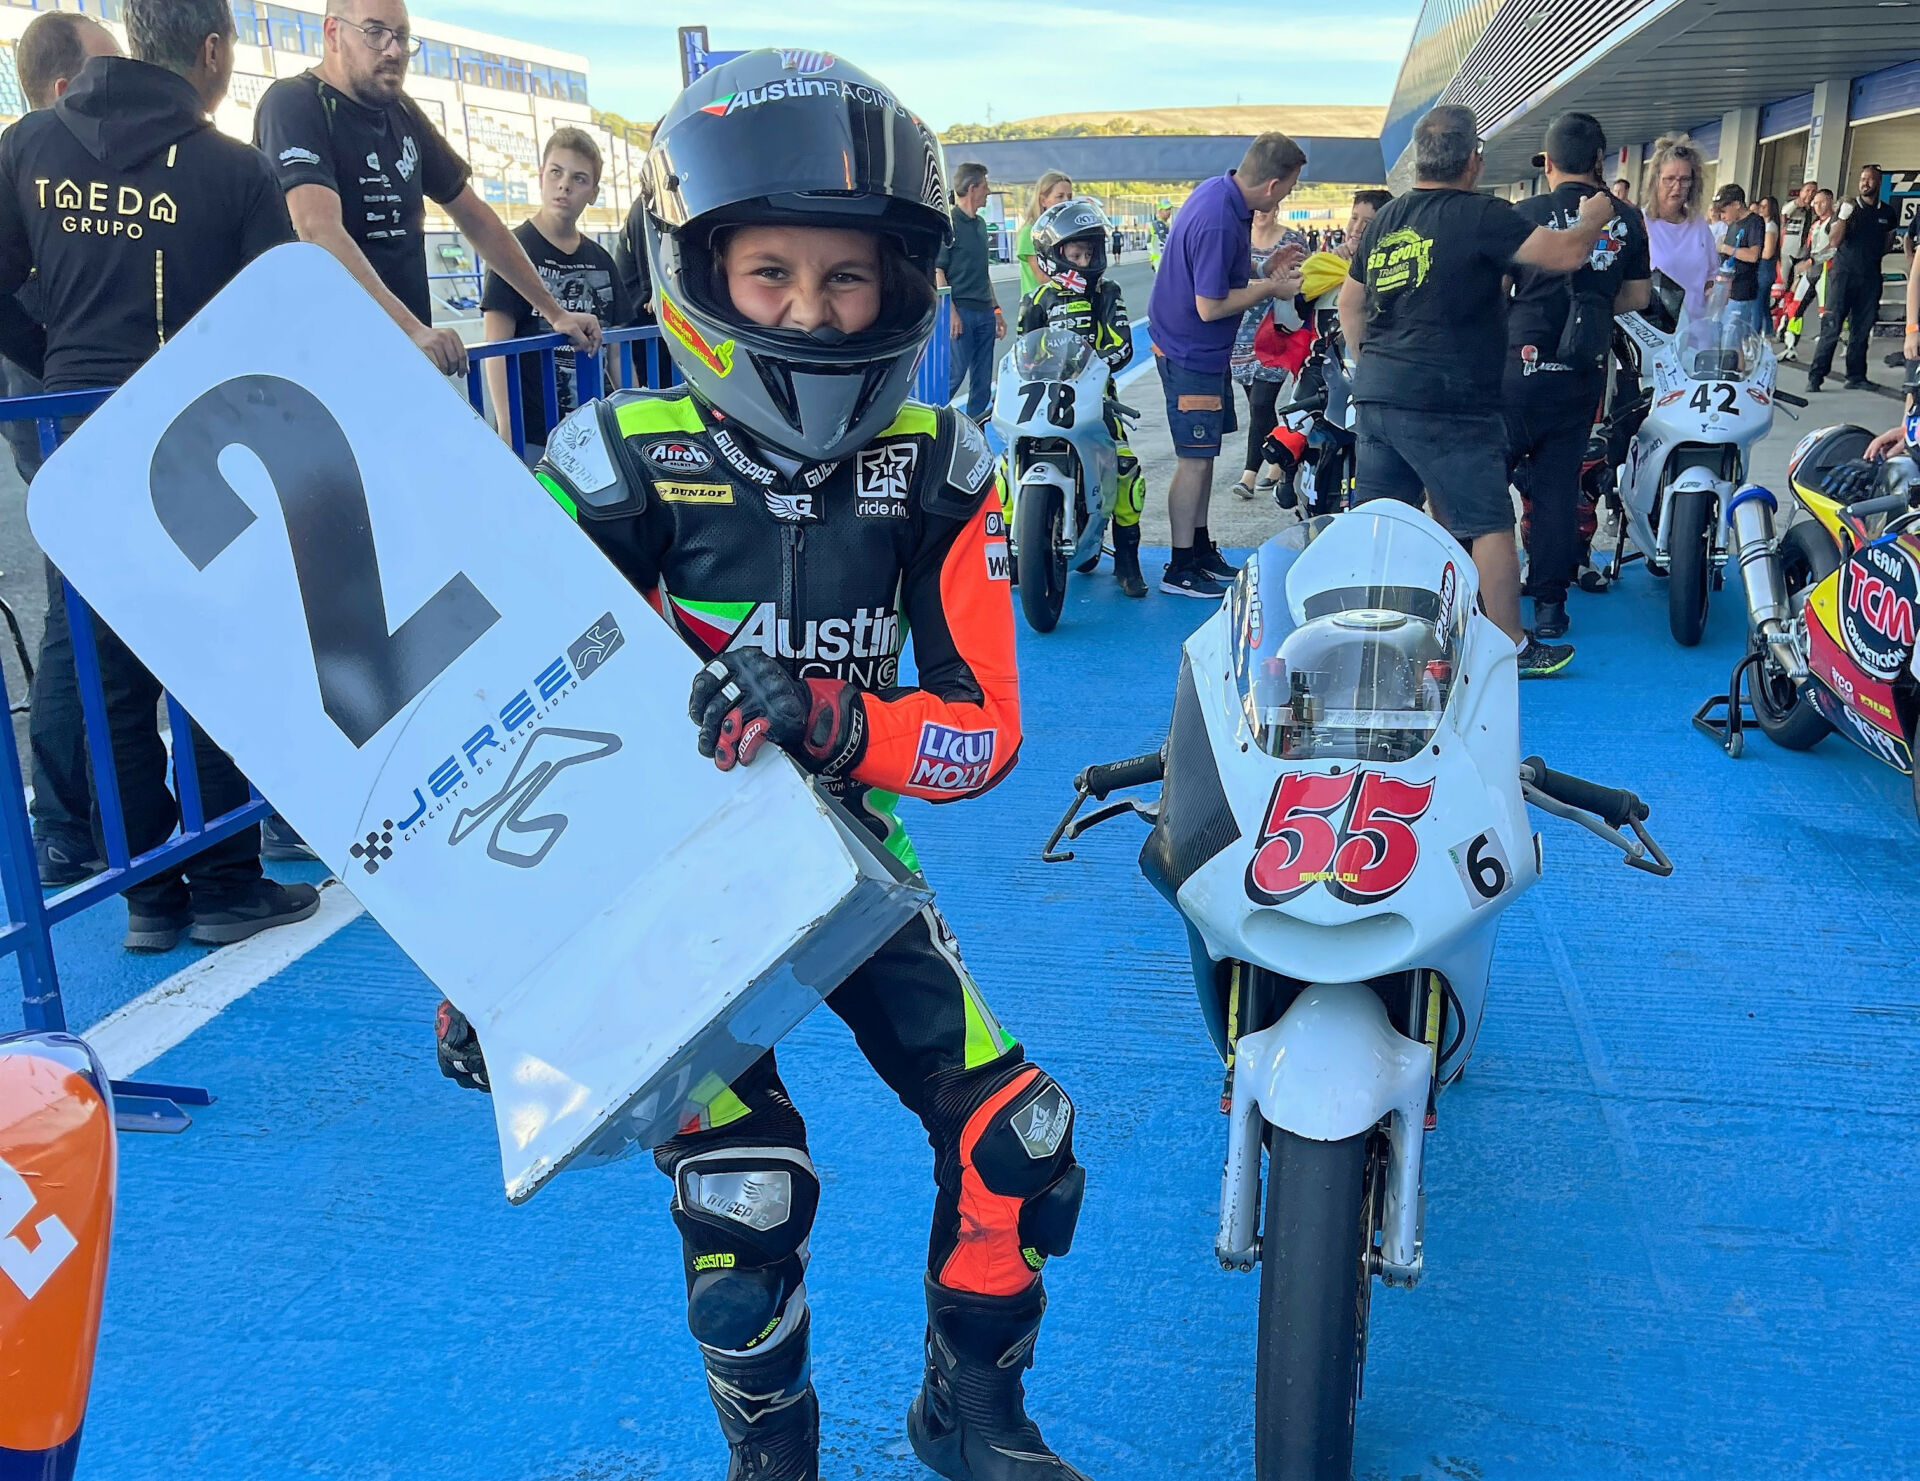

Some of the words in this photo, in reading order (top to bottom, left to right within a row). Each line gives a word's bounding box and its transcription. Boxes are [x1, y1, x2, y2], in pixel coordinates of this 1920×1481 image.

[62, 215, 144, 240] GRUPO
[1387, 239, 1434, 266] SPORT
[1046, 333, 1096, 348] HAWKERS
[1016, 381, 1076, 430] 78
[1689, 383, 1740, 416] 42
[651, 444, 709, 463] Airoh
[1033, 465, 1046, 474] 6
[669, 486, 727, 498] DUNLOP
[858, 500, 890, 516] ride
[150, 374, 502, 749] 2
[1866, 547, 1904, 583] TEAM
[1848, 558, 1916, 648] TCM
[725, 602, 901, 662] Austin
[1845, 615, 1909, 669] COMPETICIÓN
[397, 656, 573, 831] JEREZ
[922, 726, 994, 767] LIQUI
[404, 781, 469, 842] CIRCUITO
[476, 758, 493, 776] DE
[500, 680, 578, 753] VELOCIDAD
[913, 757, 989, 789] MOLY
[1109, 757, 1145, 772] domino
[1246, 763, 1437, 904] 55
[1299, 871, 1334, 883] MIKEY
[1336, 872, 1358, 883] LOU
[1466, 832, 1506, 899] 6
